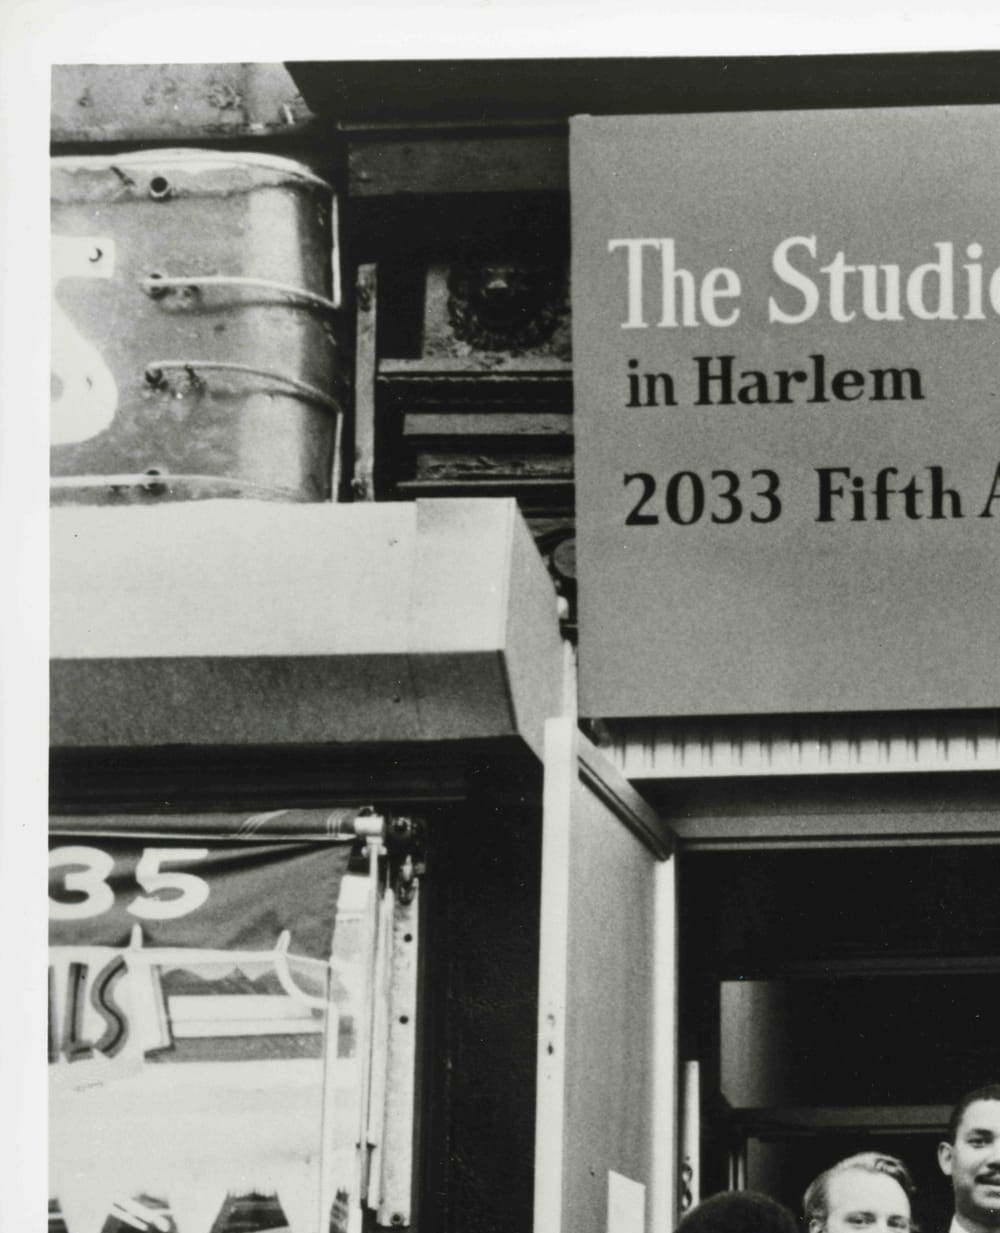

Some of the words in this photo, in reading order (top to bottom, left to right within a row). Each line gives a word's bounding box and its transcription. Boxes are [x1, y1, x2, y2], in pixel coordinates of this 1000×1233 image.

[607, 237, 742, 329] The
[624, 357, 679, 409] in
[691, 353, 927, 407] Harlem
[622, 468, 783, 527] 2033
[813, 464, 966, 524] Fifth
